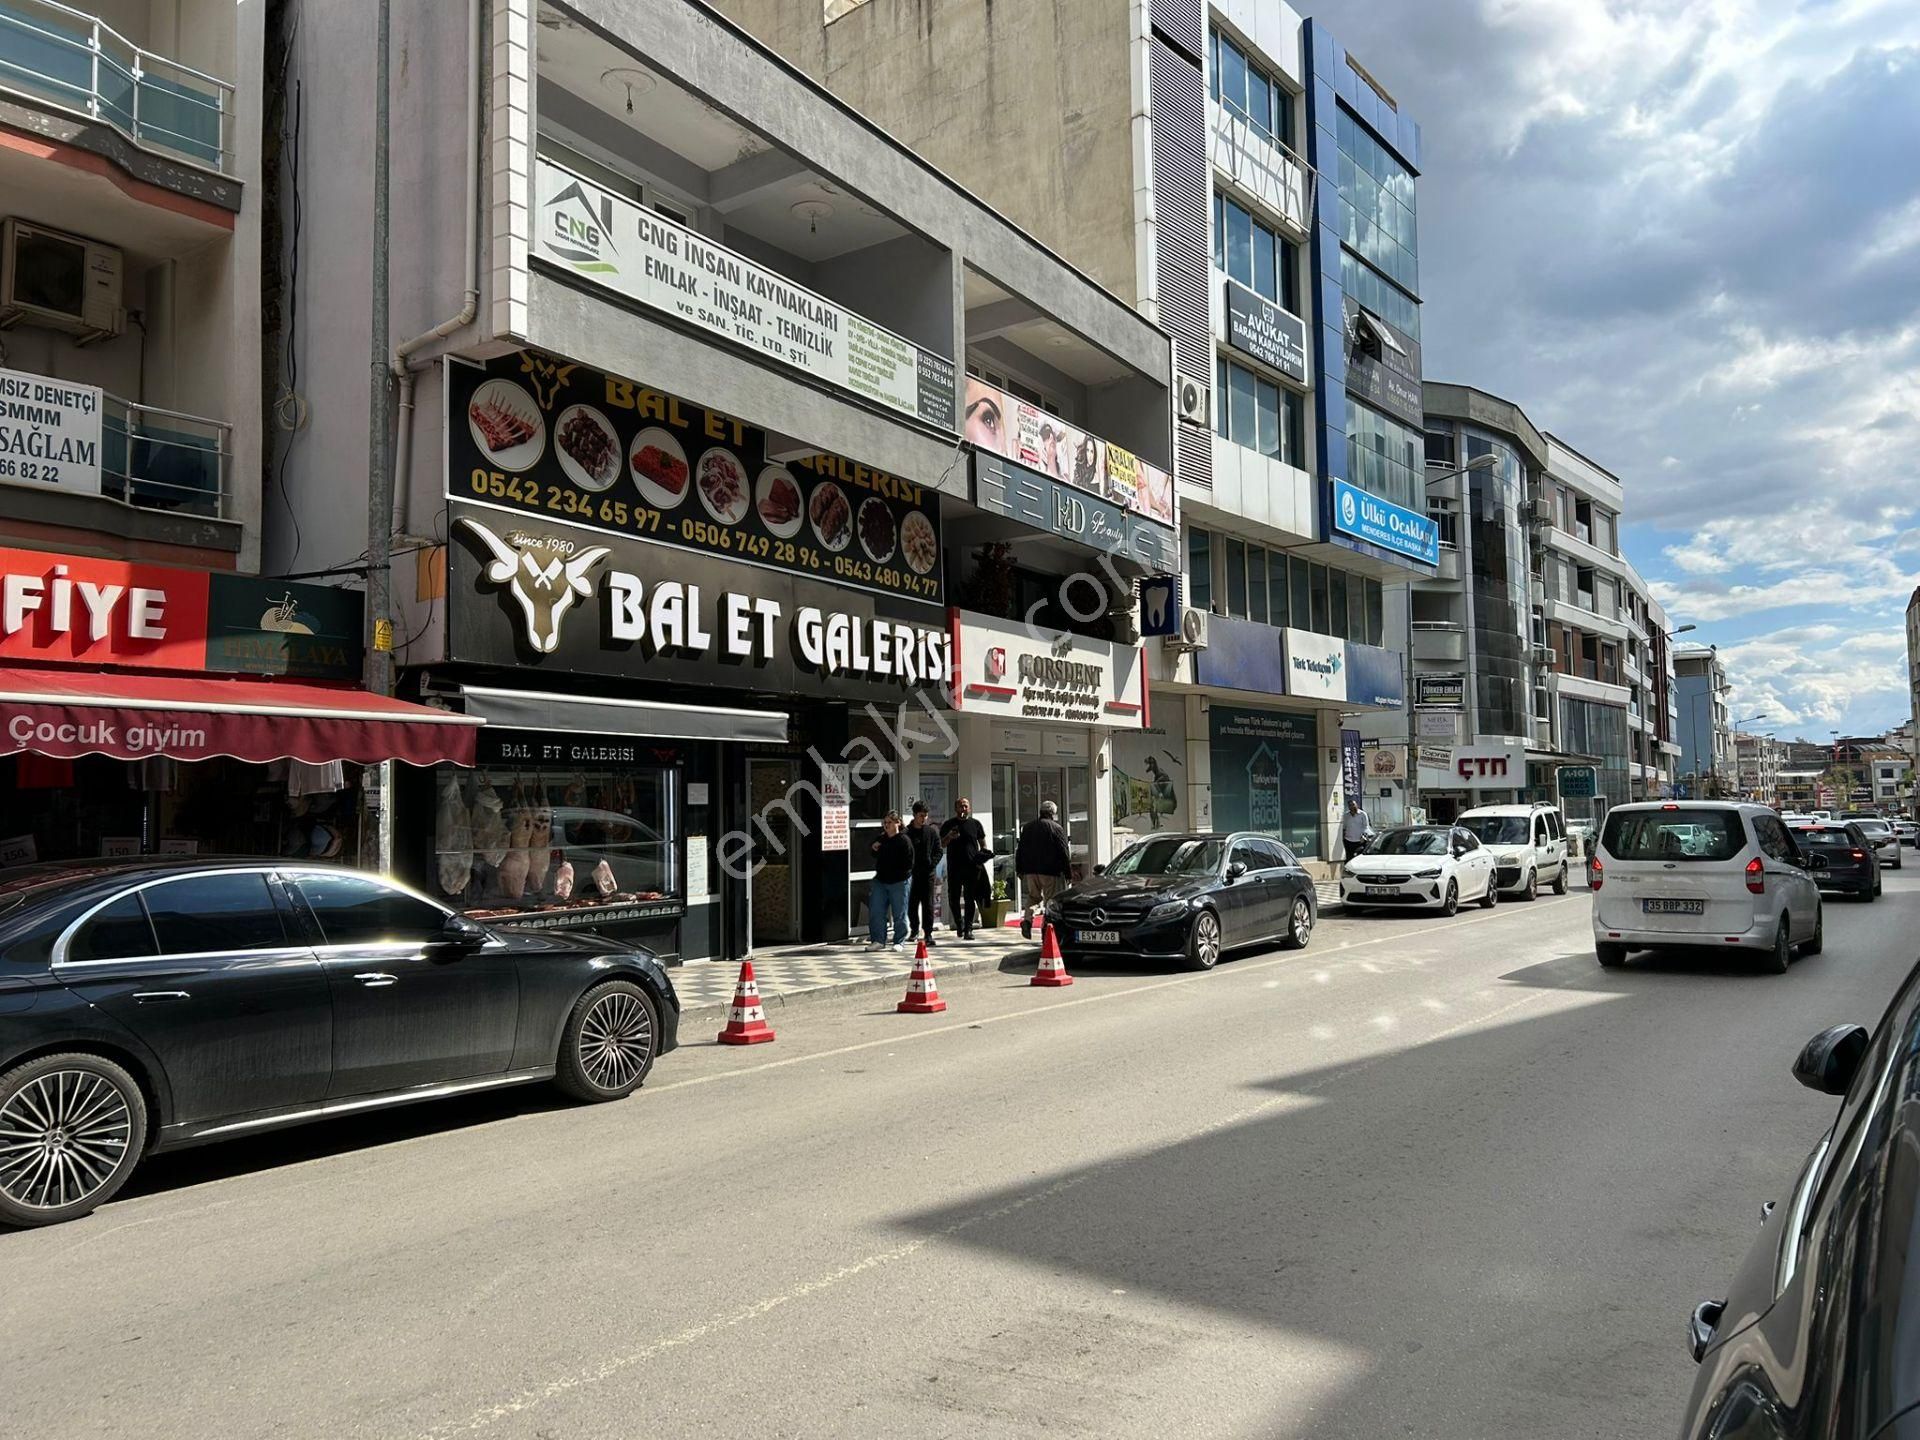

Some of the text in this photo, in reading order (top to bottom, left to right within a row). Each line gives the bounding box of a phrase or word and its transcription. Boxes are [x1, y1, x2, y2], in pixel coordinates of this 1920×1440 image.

[555, 211, 599, 247] CNG
[637, 217, 838, 332] CNG İNSAN KAYNAKLARI
[645, 255, 697, 297] EMLAK
[713, 282, 763, 326] İNŞAAT
[776, 316, 833, 358] TEMİZLİK
[676, 301, 811, 366] ve SAN. TİC. LTD. ŞTİ.
[1233, 321, 1257, 343] BARAN
[1248, 313, 1290, 347] AVUKAT
[34, 384, 96, 415] DENETÇİ
[605, 375, 689, 428] BAL
[705, 407, 750, 446] ET
[0, 425, 96, 467] SAĞLAM
[20, 462, 38, 480] 82
[42, 465, 59, 483] 22
[471, 468, 539, 506] 0542
[547, 486, 593, 518] 234
[600, 499, 628, 525] 65
[634, 506, 661, 533] 97
[682, 518, 731, 549] 0506
[735, 530, 769, 561] 749
[774, 539, 796, 563] 28
[800, 546, 819, 569] 96
[835, 555, 872, 581] 0543
[874, 566, 900, 588] 480
[903, 573, 919, 593] 94
[922, 578, 938, 597] 77
[513, 533, 575, 554] since 1980
[3, 563, 169, 643] FİYE
[610, 571, 711, 654] BAL
[726, 591, 782, 658] ET
[1293, 656, 1331, 674] Türk Telekom
[8, 716, 206, 752] Çocuk giyim
[501, 744, 531, 758] BAL
[543, 746, 562, 759] ET
[1100, 932, 1116, 941] 768
